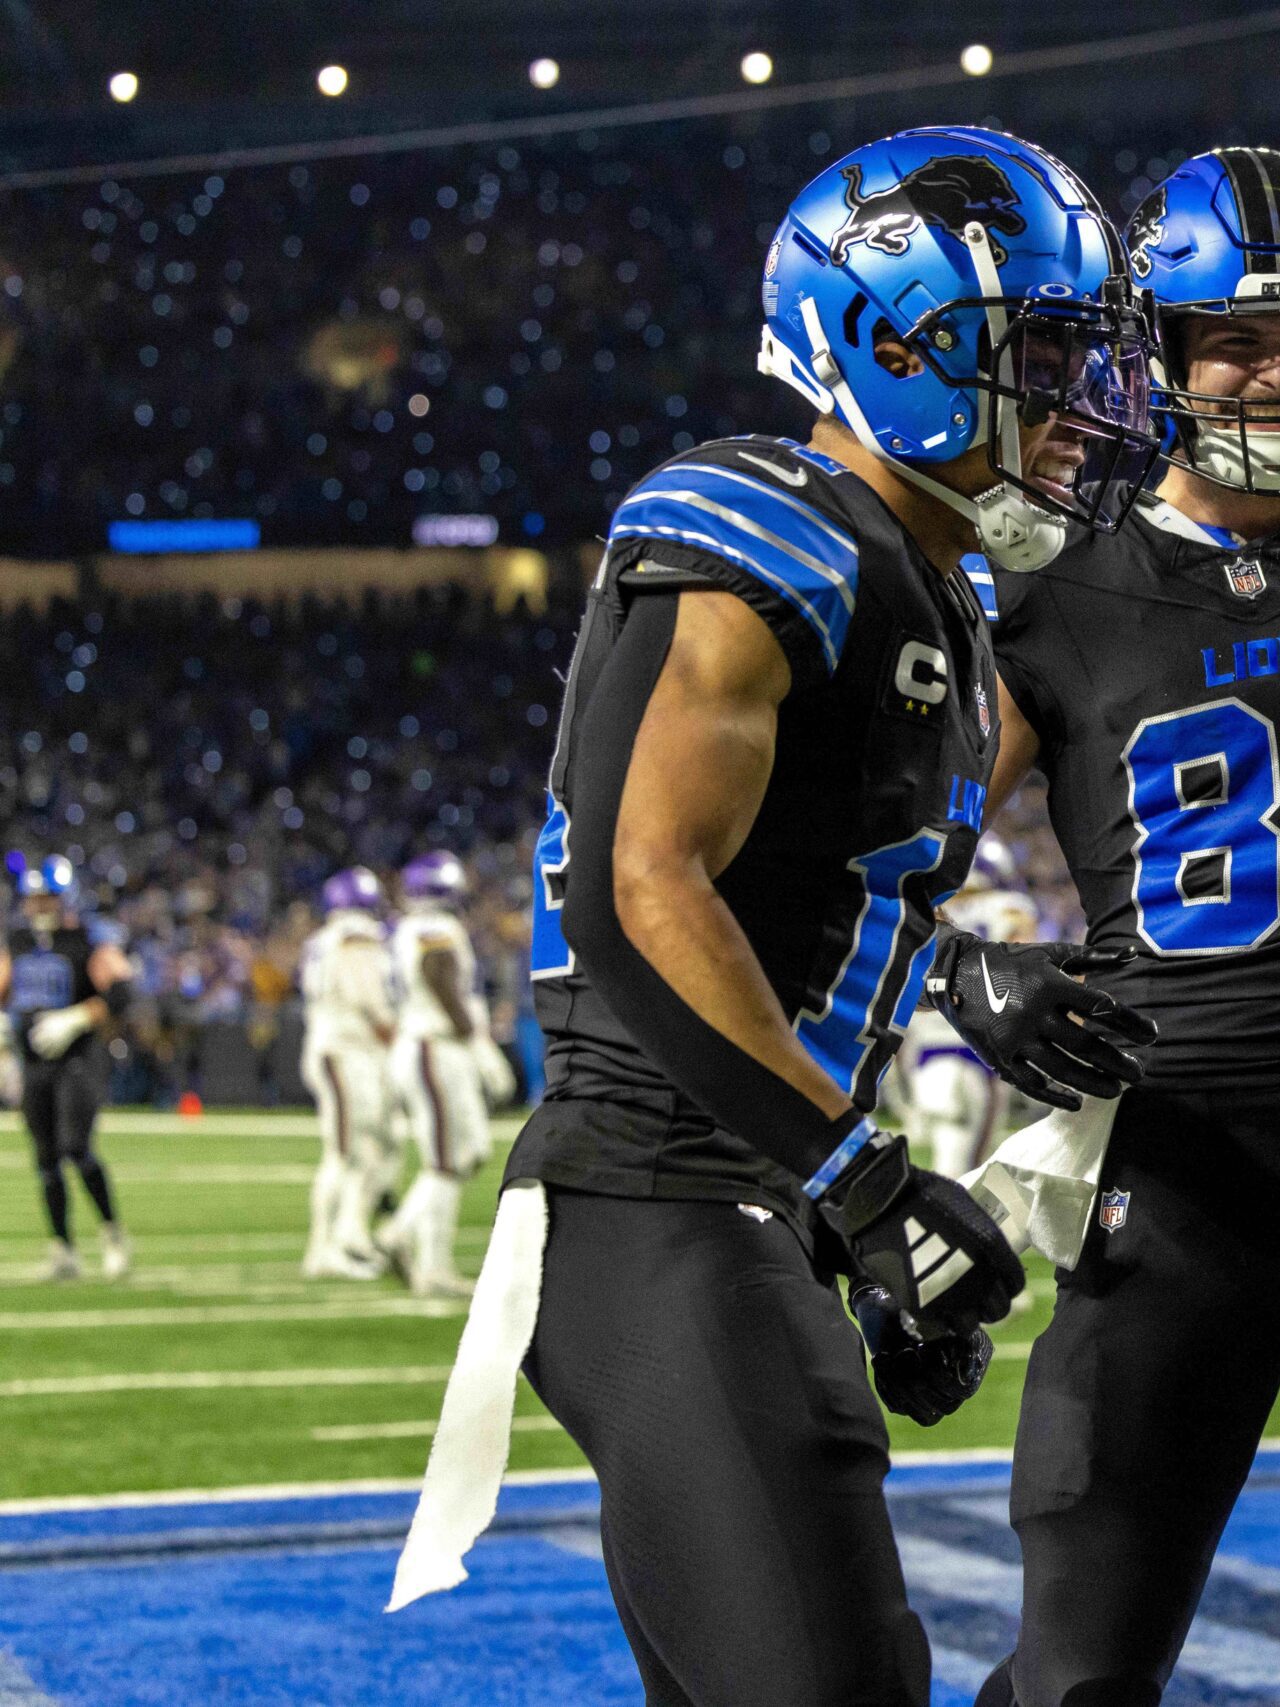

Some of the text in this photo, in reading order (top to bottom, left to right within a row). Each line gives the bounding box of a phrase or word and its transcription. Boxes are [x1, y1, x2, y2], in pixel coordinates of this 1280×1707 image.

[1234, 573, 1262, 593] NFL
[895, 640, 948, 705] C
[1103, 1207, 1122, 1225] NFL
